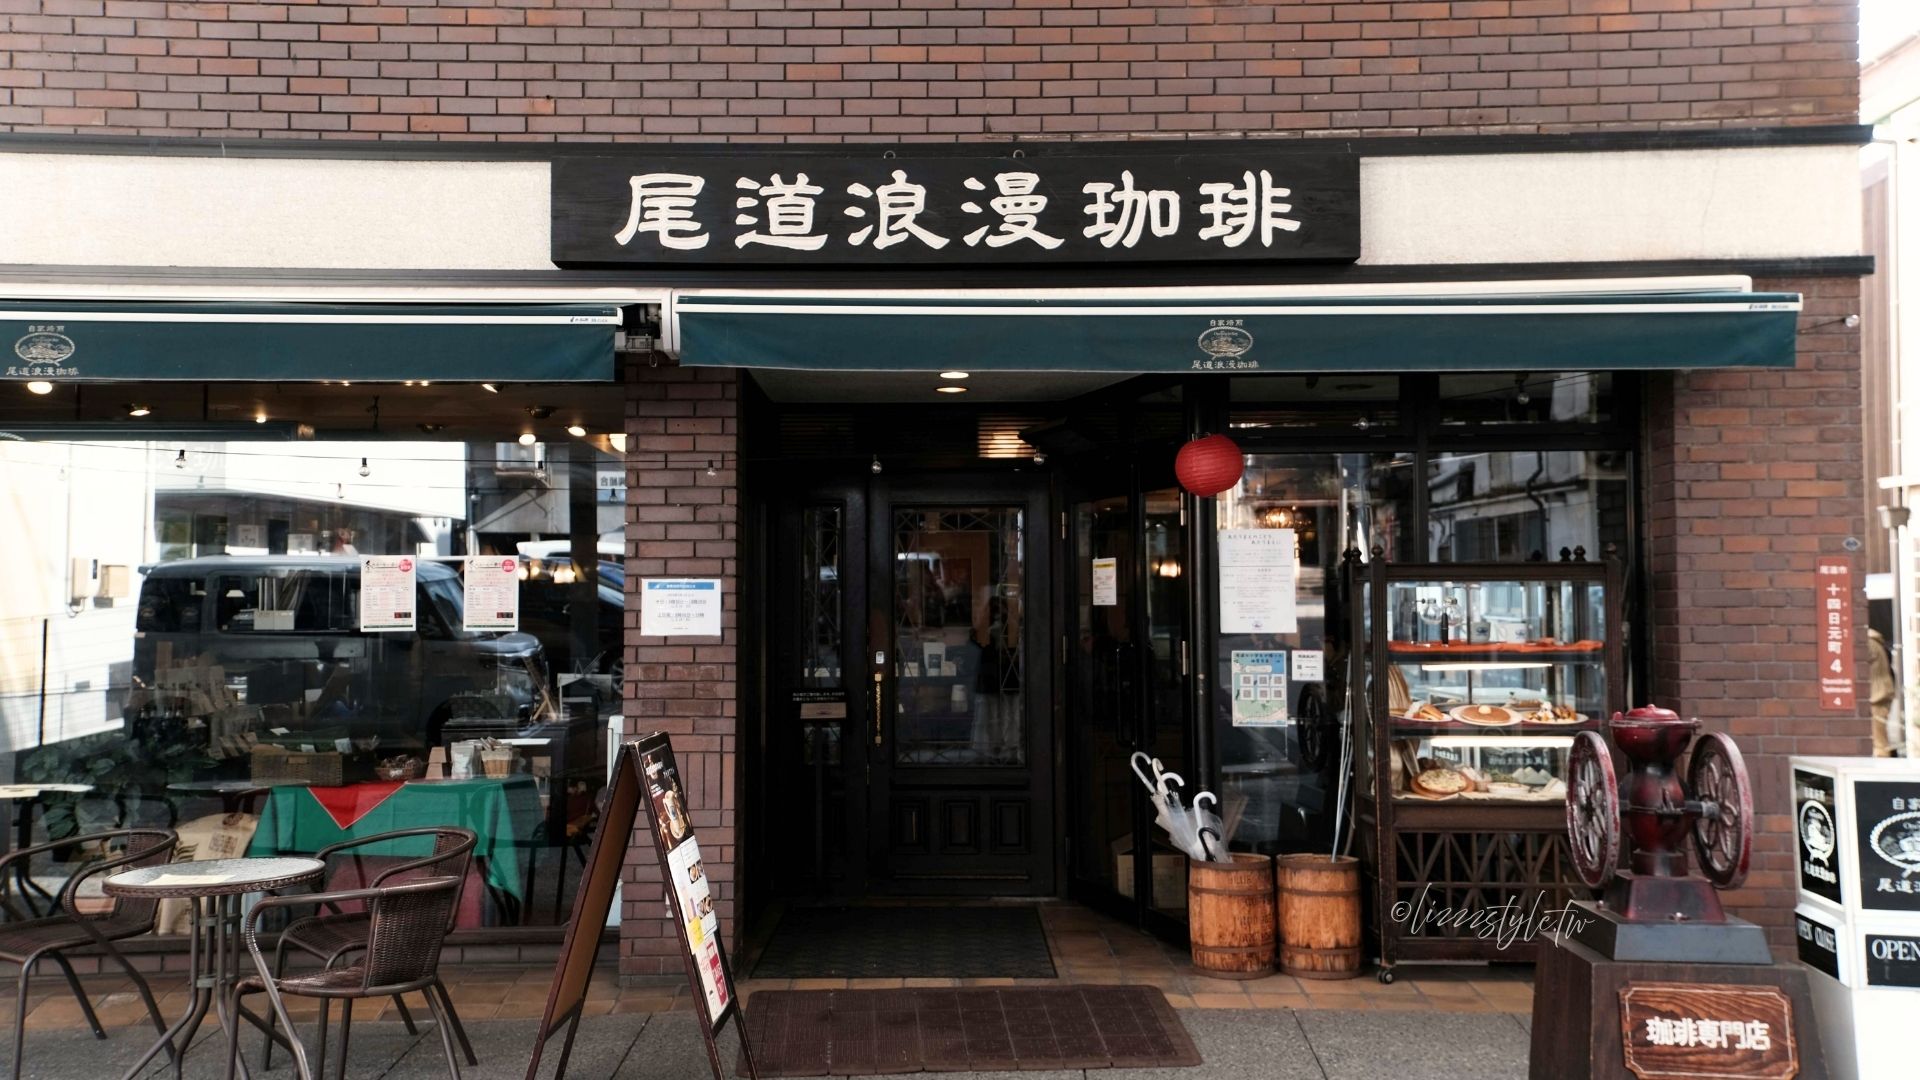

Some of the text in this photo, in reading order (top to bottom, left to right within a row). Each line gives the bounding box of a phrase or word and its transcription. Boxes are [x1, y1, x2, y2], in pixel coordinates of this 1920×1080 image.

[614, 170, 1301, 250] 尾道浪漫珈琲
[6, 366, 79, 376] 尾道浪漫珈琲
[1191, 360, 1260, 370] 尾道浪漫珈琲
[1646, 1016, 1771, 1050] 珈琲専門店
